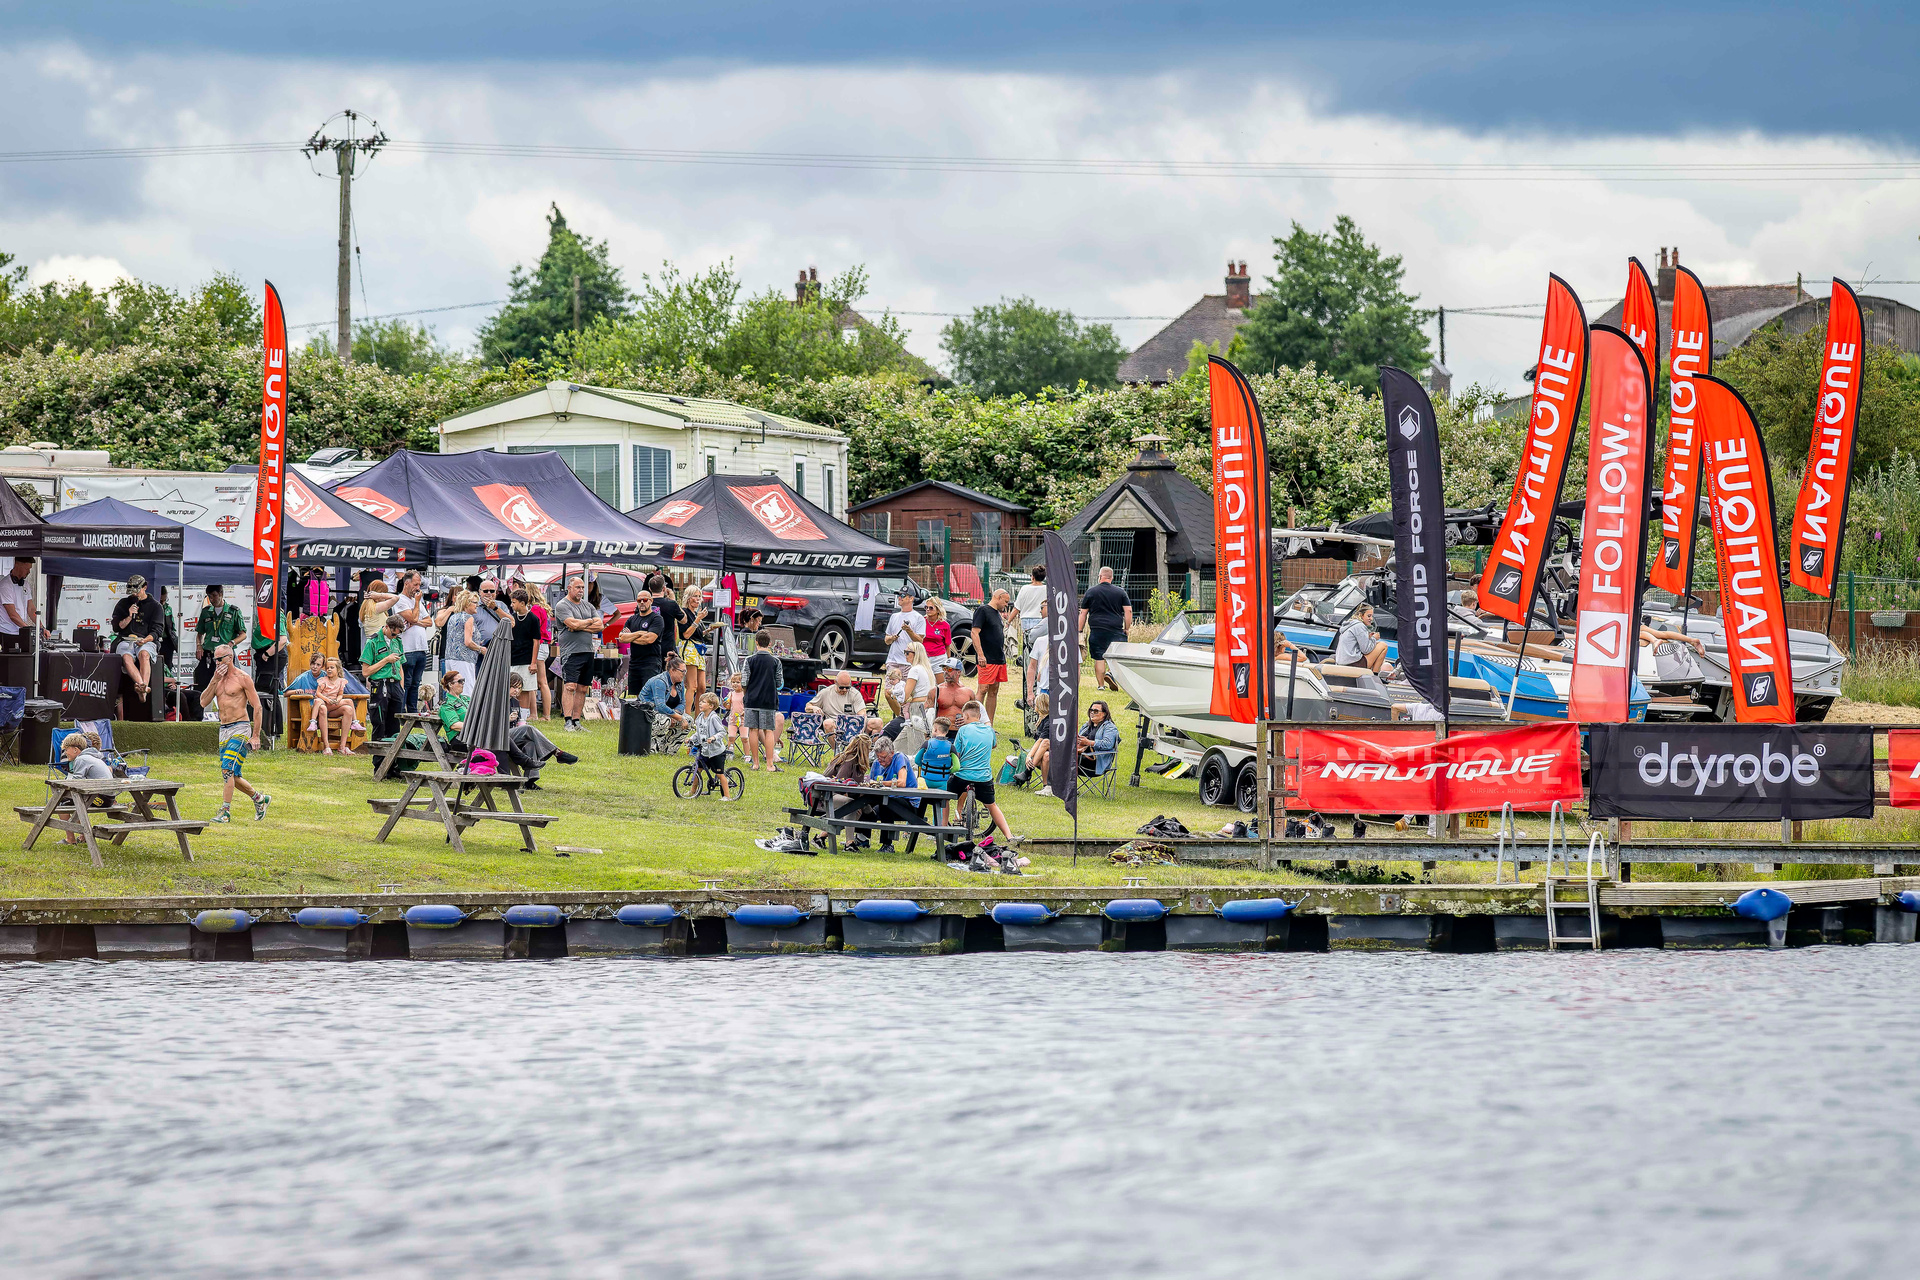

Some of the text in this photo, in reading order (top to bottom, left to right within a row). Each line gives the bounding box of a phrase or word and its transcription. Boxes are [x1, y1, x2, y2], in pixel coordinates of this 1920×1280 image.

[677, 462, 687, 470] 187
[1592, 413, 1632, 595] FOLLOW.
[82, 533, 145, 548] WAKEBOARD UK
[301, 544, 393, 560] NAUTIQUE
[1407, 450, 1433, 666] LIQUID FORCE
[766, 553, 871, 568] NAUTIQUE
[68, 678, 107, 695] NAUTIQUE
[1319, 753, 1559, 781] NAUTIQUE
[1470, 819, 1485, 827] KTT
